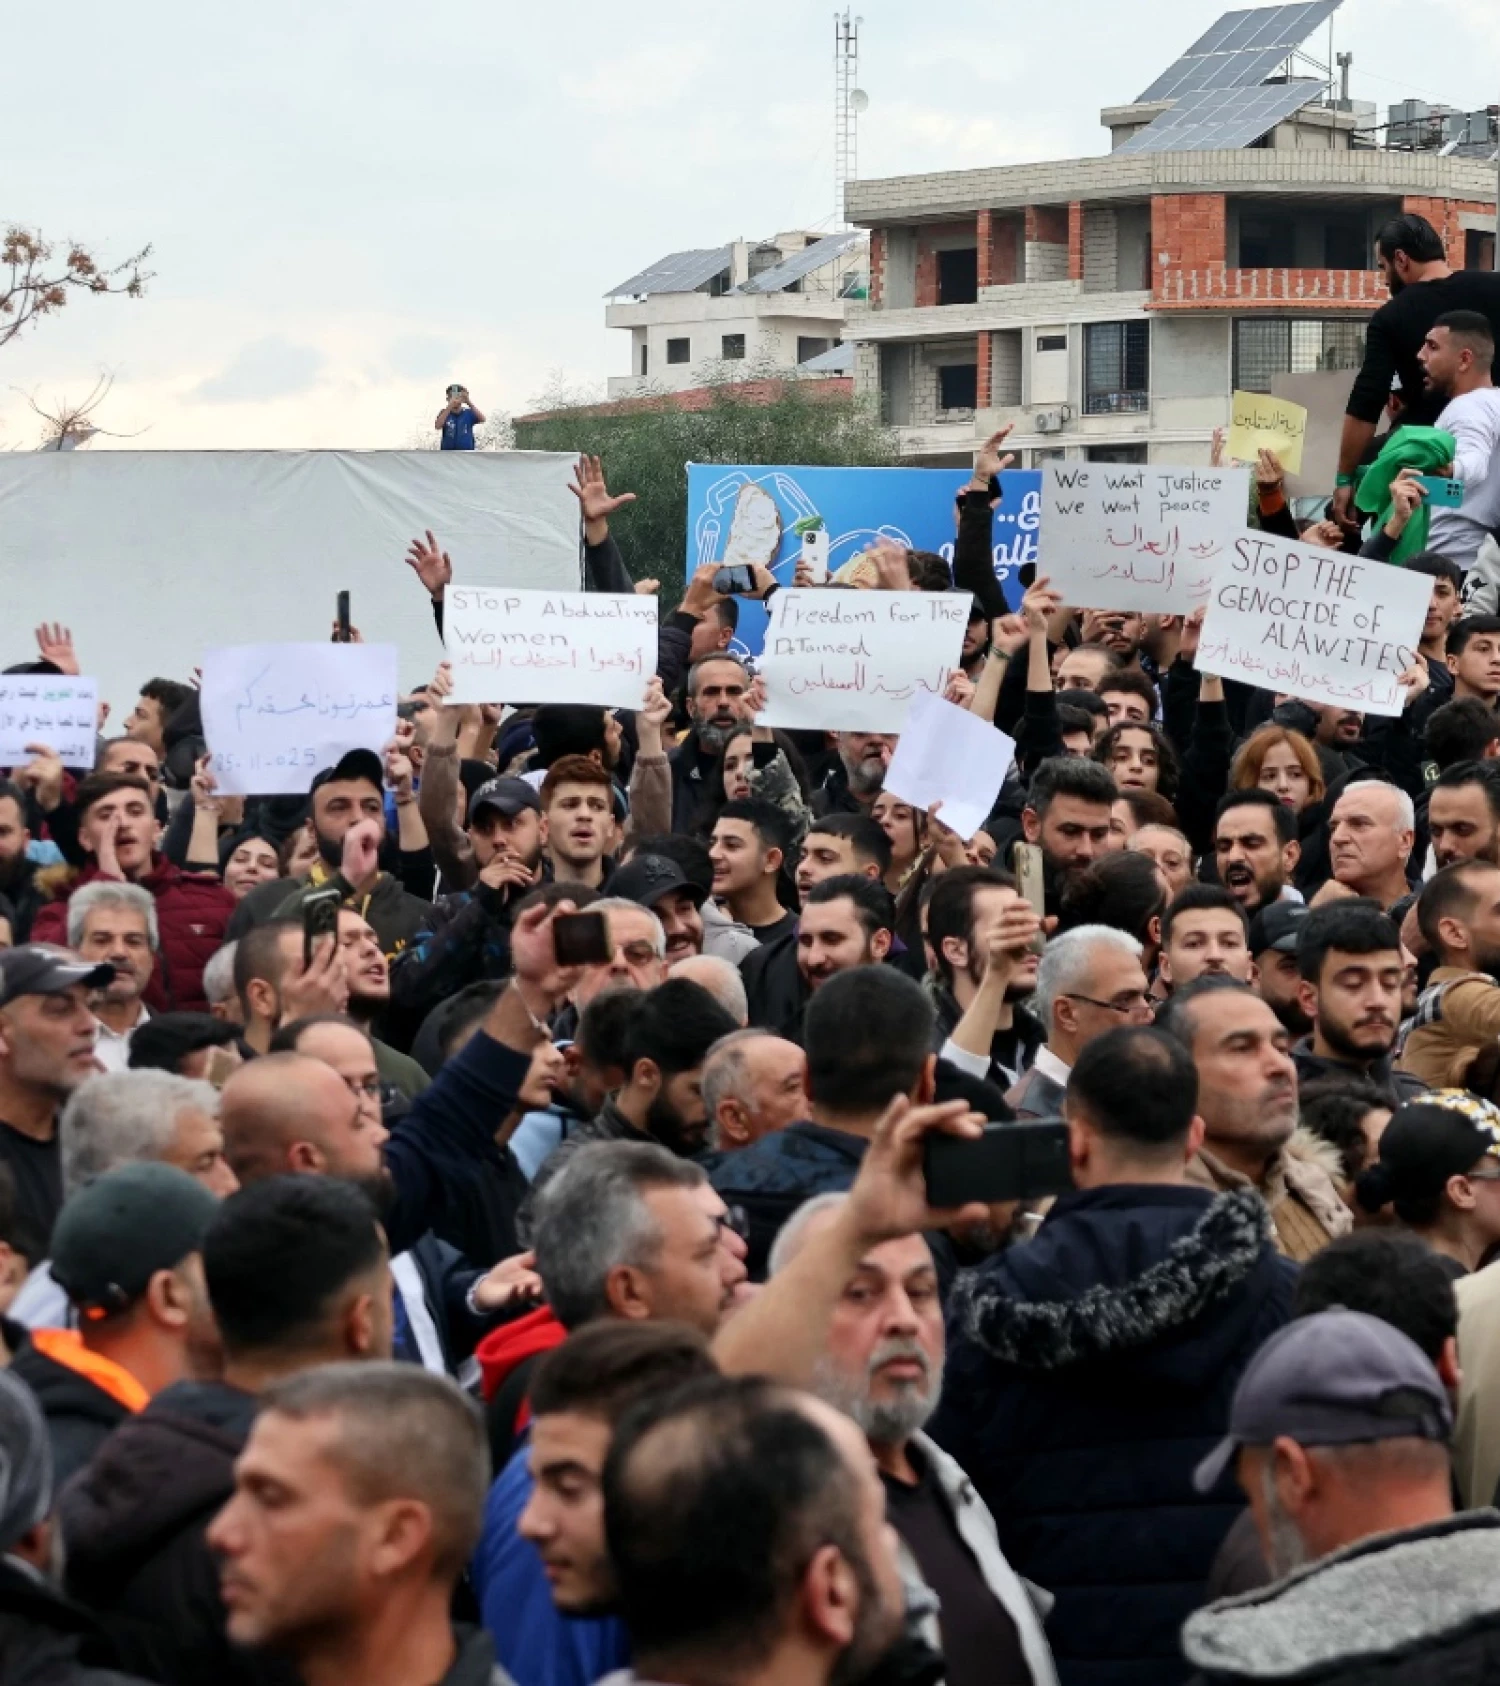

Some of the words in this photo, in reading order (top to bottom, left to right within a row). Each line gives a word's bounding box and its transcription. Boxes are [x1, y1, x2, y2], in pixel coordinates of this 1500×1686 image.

[1054, 468, 1089, 488] We
[1157, 471, 1222, 498] Justice
[1159, 501, 1210, 523] peace
[1309, 556, 1365, 600] THE
[780, 594, 876, 628] Freedom
[927, 600, 964, 623] The
[1218, 584, 1341, 627] GENOCIDE
[453, 626, 568, 646] Women
[1261, 621, 1415, 676] ALAWITES
